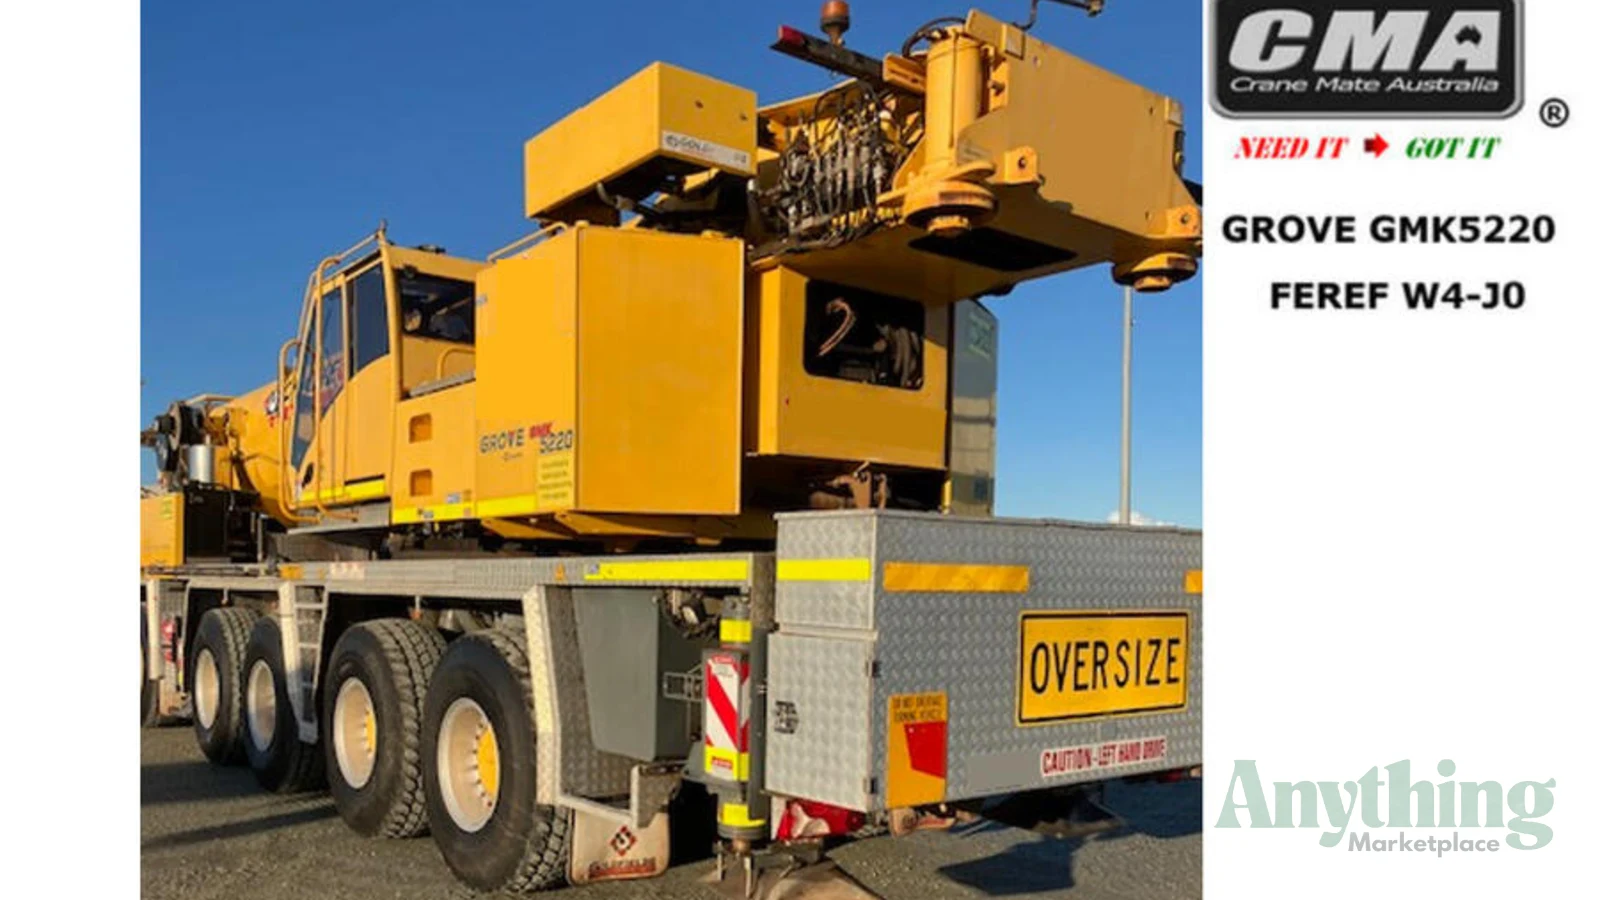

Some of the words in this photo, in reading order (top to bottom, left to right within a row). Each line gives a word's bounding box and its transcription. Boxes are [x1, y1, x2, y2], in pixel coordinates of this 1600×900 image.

[480, 427, 525, 453] GROVE
[540, 429, 573, 454] 5220
[1030, 637, 1181, 694] OVERSIZE
[1118, 741, 1141, 763] HAND
[1143, 739, 1165, 760] DRIVE
